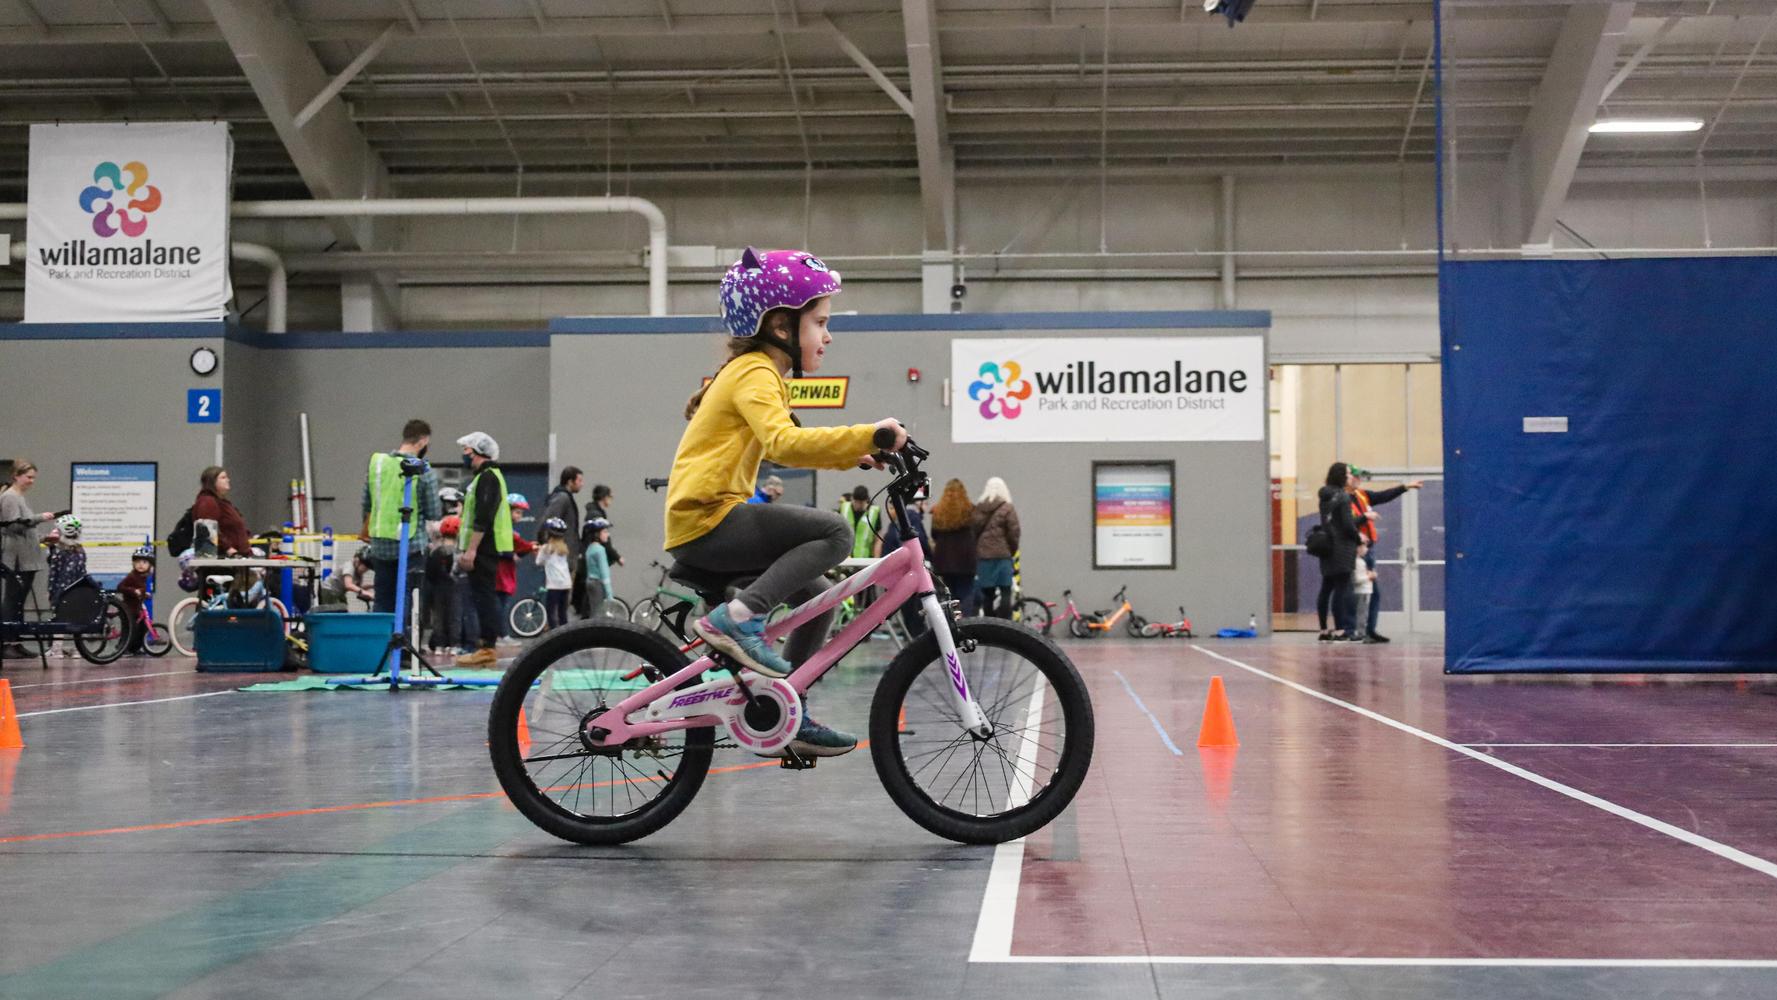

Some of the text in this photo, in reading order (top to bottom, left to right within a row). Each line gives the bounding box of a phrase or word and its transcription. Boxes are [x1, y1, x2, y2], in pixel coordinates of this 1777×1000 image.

[40, 239, 201, 266] willamalane
[49, 267, 191, 280] Park and Recreation District
[1035, 360, 1248, 394] willamalane
[790, 385, 841, 400] CHWAB
[198, 395, 210, 417] 2
[1038, 396, 1225, 410] Park and Recreation District
